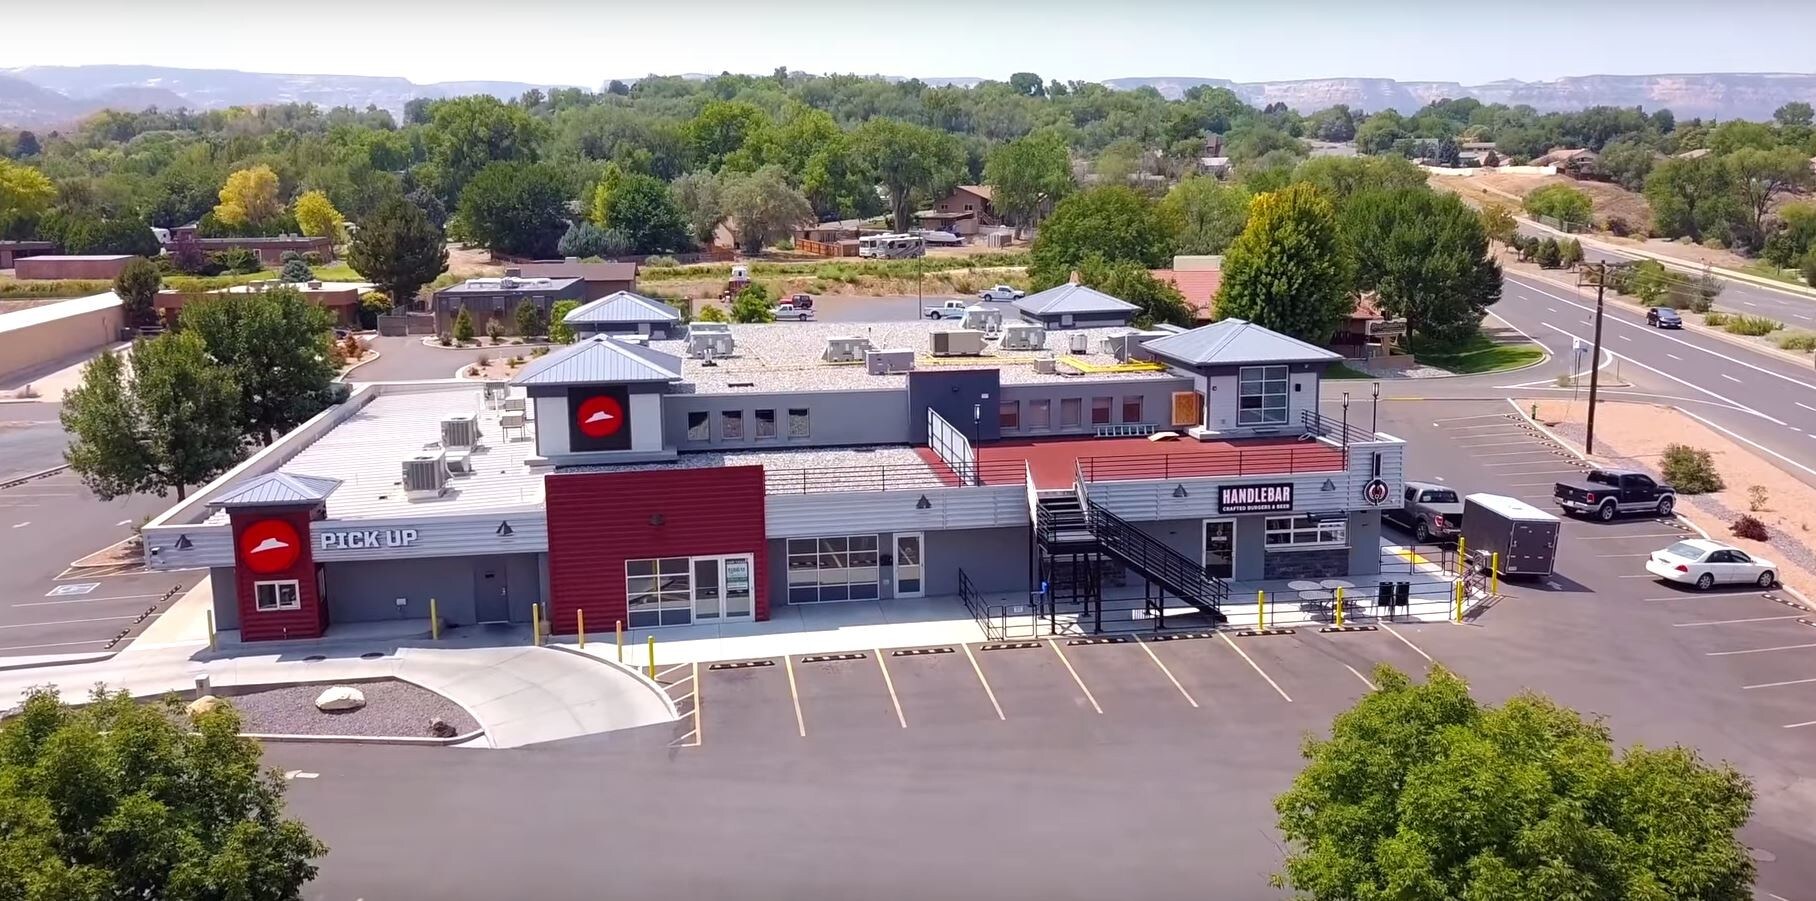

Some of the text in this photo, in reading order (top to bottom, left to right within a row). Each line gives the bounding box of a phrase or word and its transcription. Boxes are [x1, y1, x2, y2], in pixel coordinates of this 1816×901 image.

[1222, 486, 1291, 504] HANDLEBAR
[320, 529, 418, 549] PICK UP
